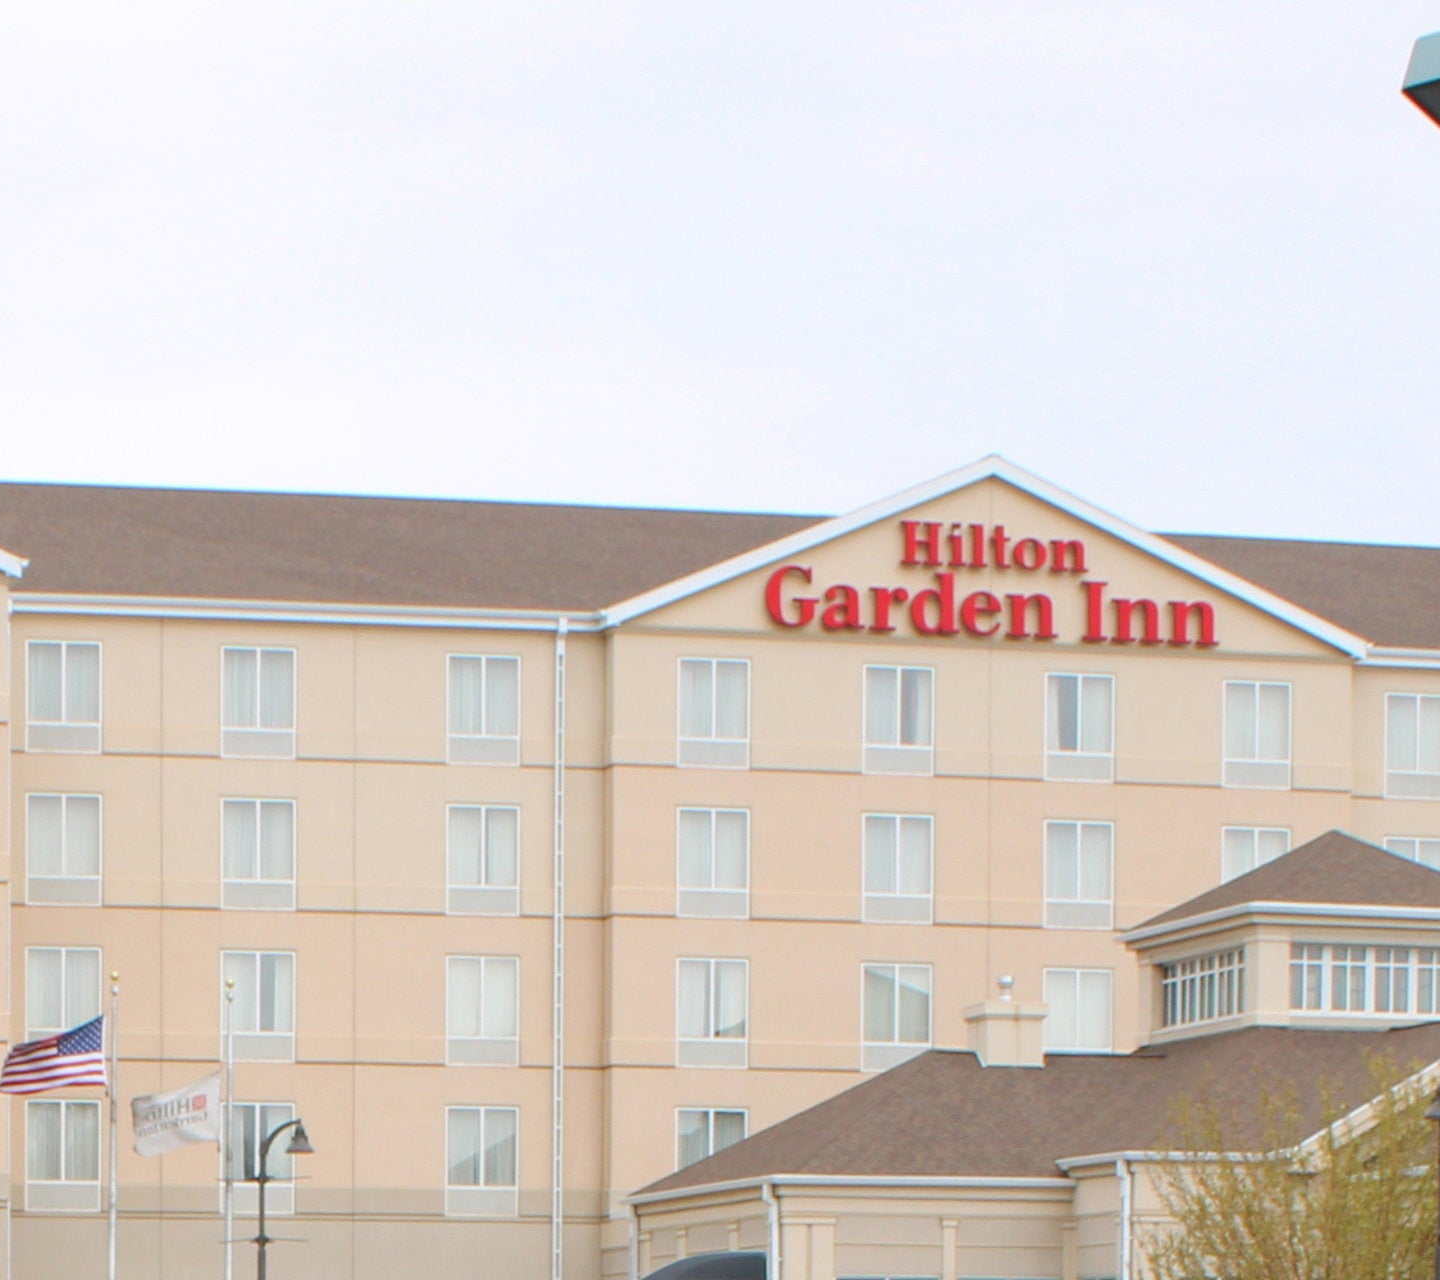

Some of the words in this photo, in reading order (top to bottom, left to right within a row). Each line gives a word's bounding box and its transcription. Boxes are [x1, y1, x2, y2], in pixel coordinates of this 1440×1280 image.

[900, 519, 1088, 573] Hilton
[764, 564, 1059, 641] Garden
[1080, 579, 1220, 648] Inn
